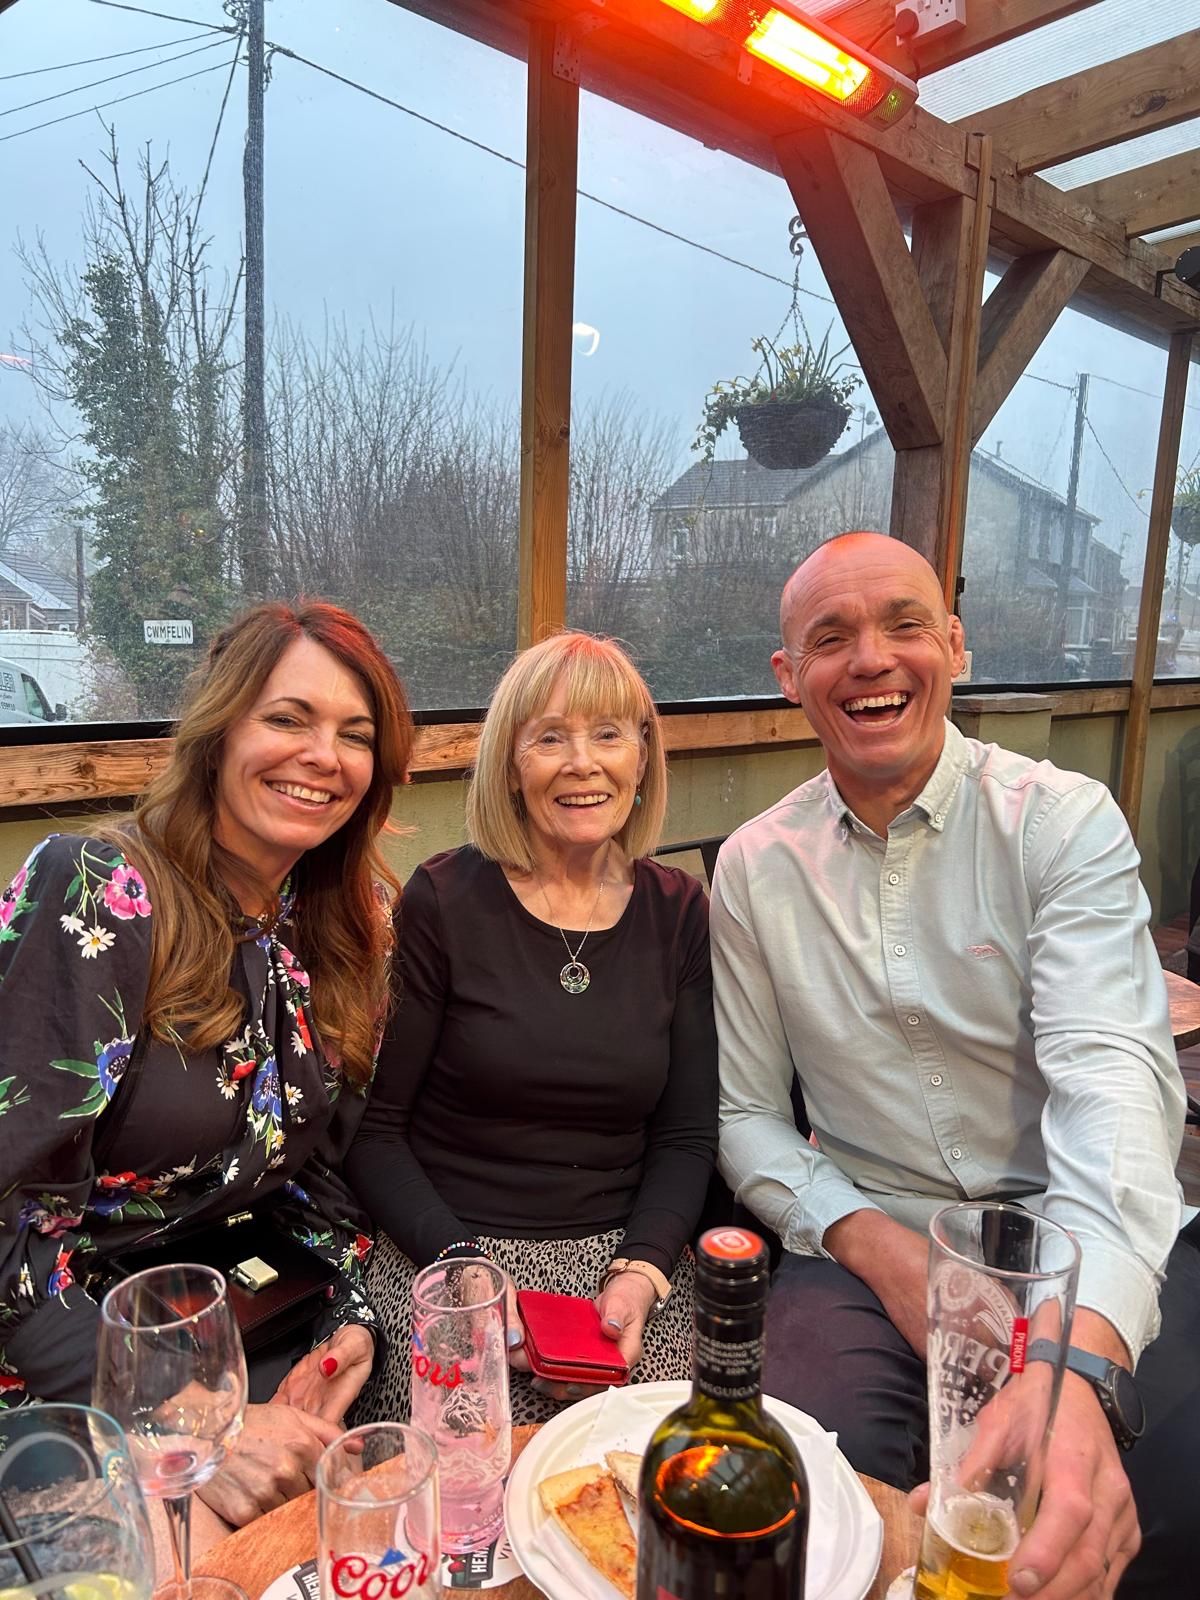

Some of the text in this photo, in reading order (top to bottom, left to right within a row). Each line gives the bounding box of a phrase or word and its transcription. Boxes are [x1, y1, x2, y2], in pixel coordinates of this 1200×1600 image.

[146, 625, 191, 639] CWMFELIN
[1012, 1332, 1026, 1369] PERONI
[415, 1355, 464, 1389] ors
